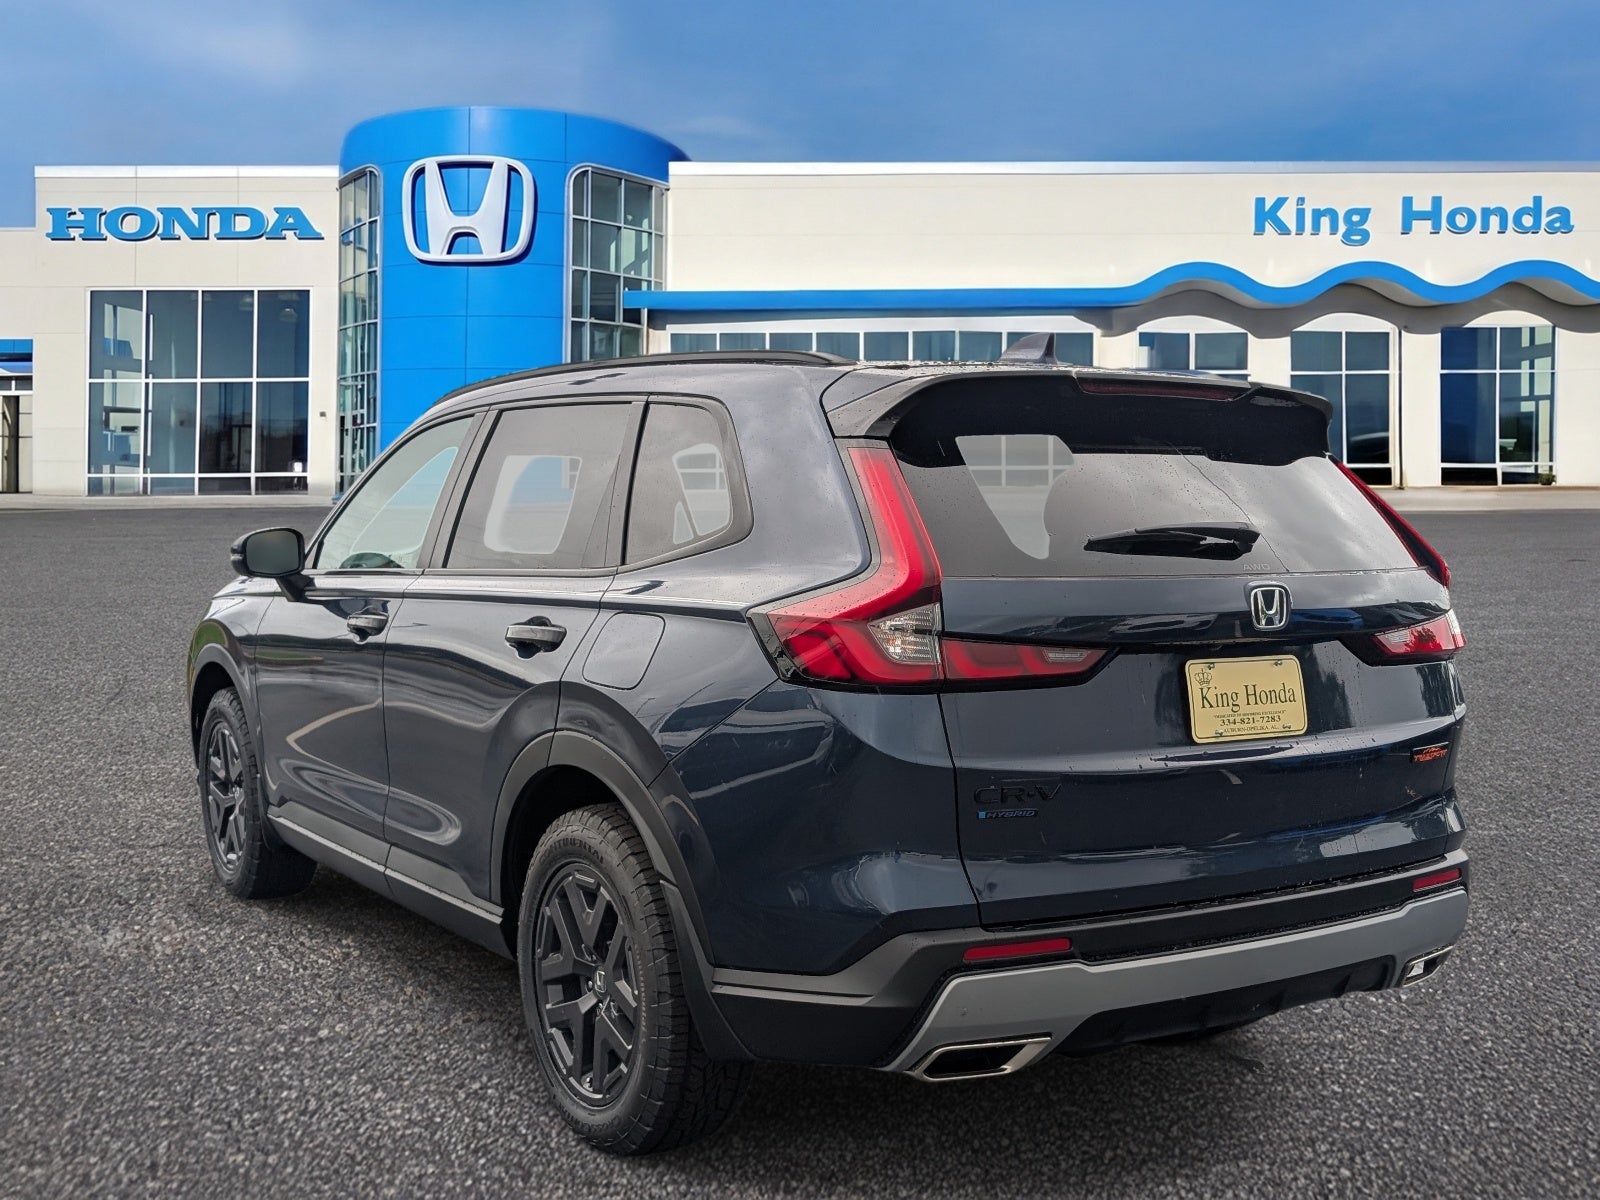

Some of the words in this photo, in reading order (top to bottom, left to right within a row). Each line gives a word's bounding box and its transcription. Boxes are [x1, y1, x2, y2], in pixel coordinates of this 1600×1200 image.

[46, 207, 324, 241] HONDA
[1253, 196, 1371, 246] King
[1401, 195, 1575, 235] Honda
[1199, 685, 1241, 713] King
[1243, 682, 1297, 706] Honda
[1220, 715, 1281, 726] 334-821-7283
[974, 783, 1062, 803] CR-V
[986, 809, 1036, 819] HYBRID
